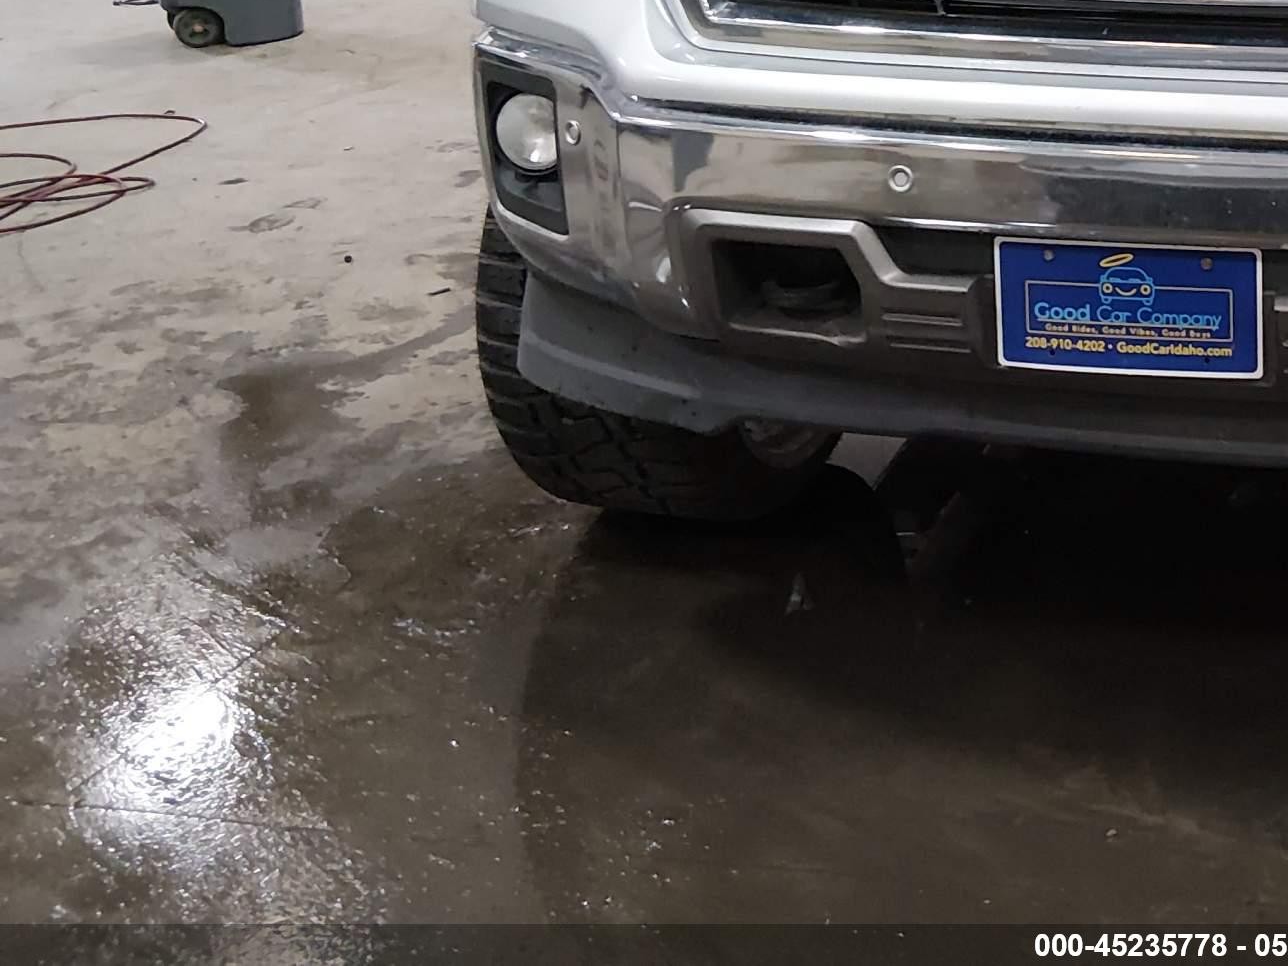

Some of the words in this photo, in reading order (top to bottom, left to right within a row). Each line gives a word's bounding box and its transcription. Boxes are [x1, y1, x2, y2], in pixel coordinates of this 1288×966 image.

[1034, 302, 1090, 320] Good
[1096, 305, 1132, 323] Car
[1137, 307, 1222, 331] Company
[1045, 323, 1068, 332] Good
[1102, 326, 1126, 335] Good
[1161, 329, 1186, 337] Good
[1025, 336, 1106, 352] 208-910-4202
[1116, 341, 1233, 357] GoodCarIdaho.com
